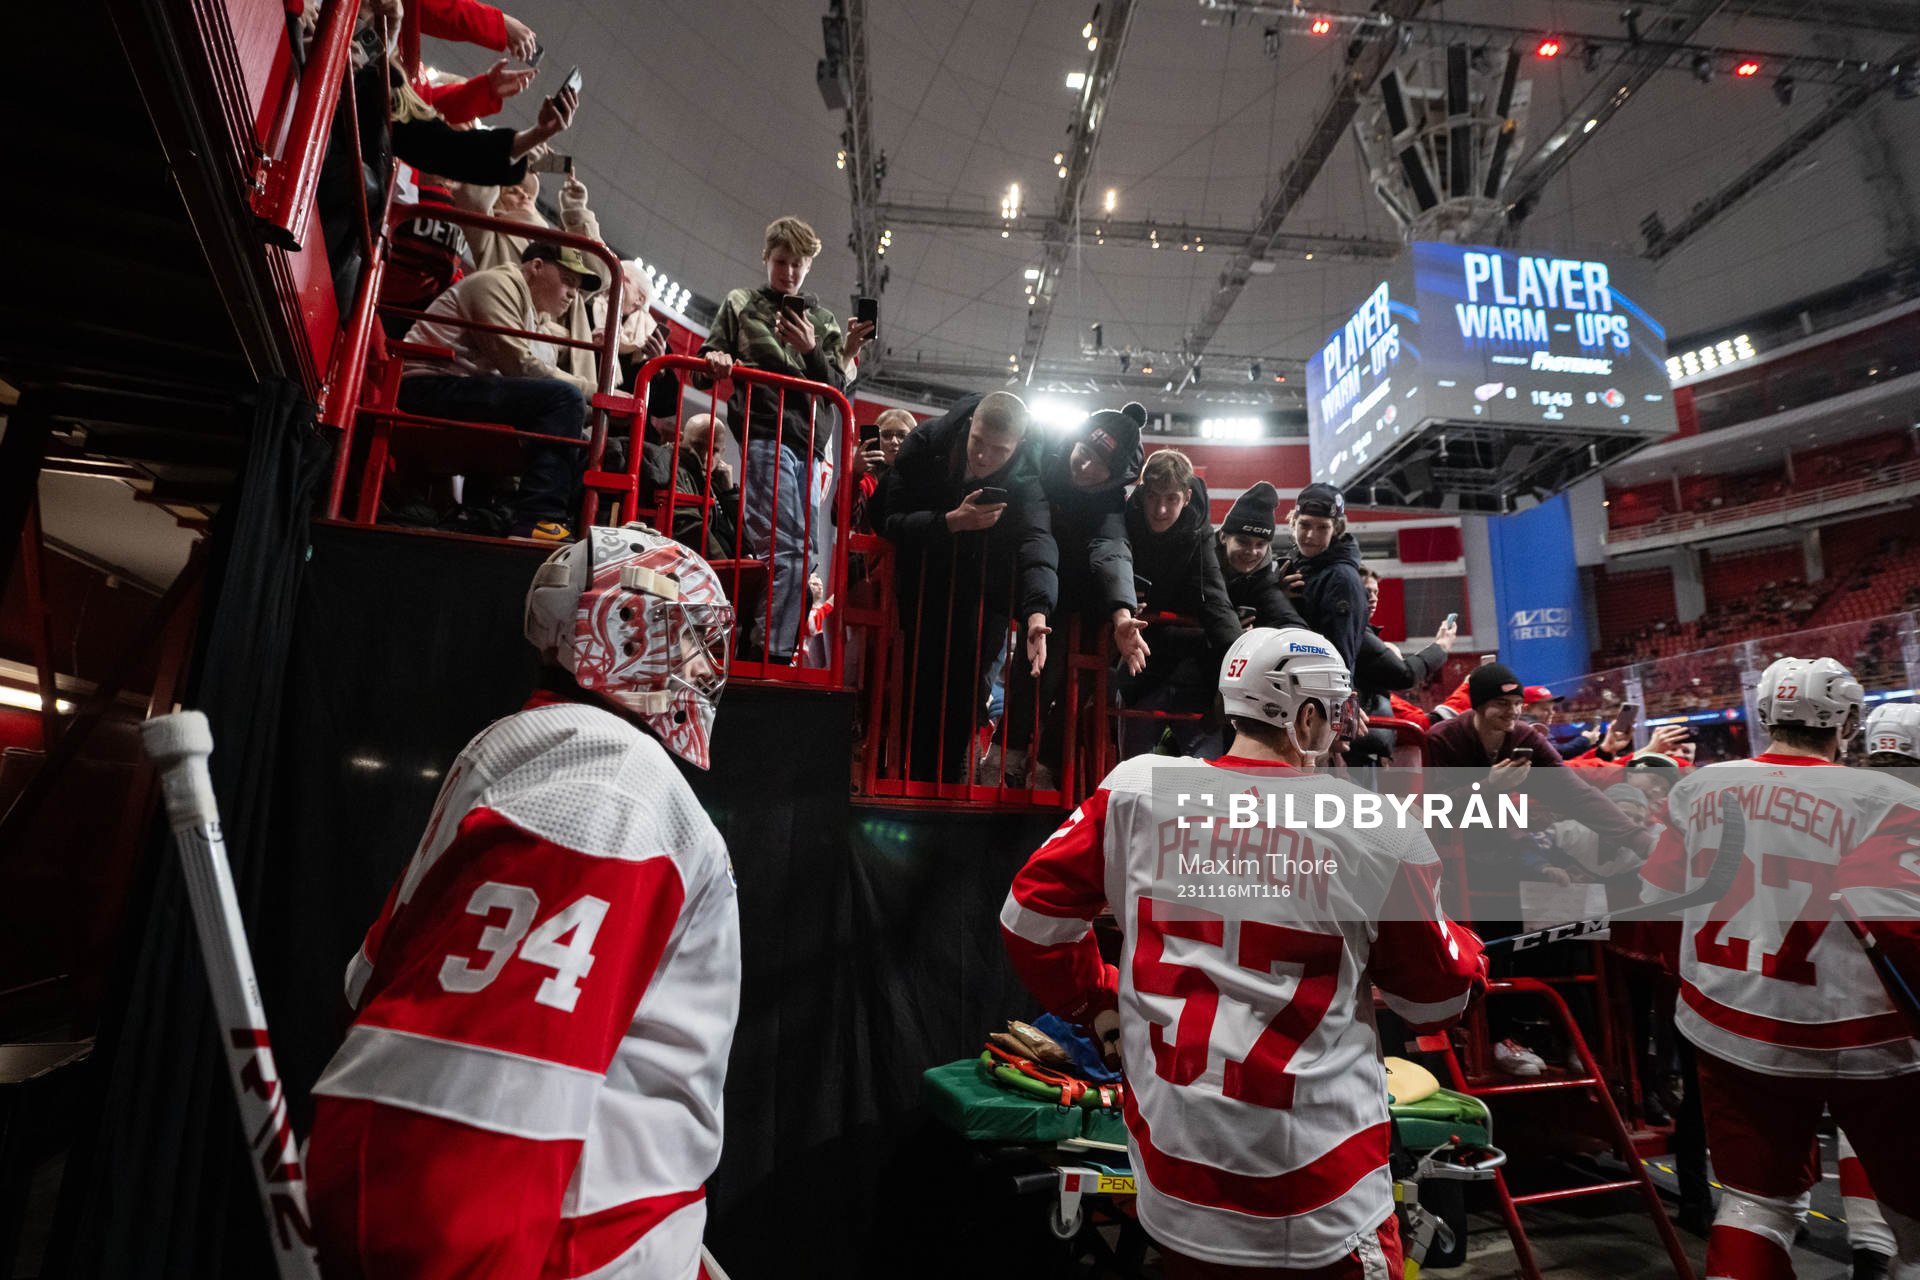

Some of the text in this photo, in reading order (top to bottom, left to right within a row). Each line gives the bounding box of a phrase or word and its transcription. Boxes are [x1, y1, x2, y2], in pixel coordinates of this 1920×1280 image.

[1463, 252, 1613, 312] PLAYER
[1323, 281, 1391, 391] PLAYER
[1227, 659, 1248, 678] 57
[1776, 685, 1798, 699] 27
[1879, 738, 1897, 750] 53
[1512, 914, 1612, 952] CCM
[1690, 847, 1839, 986] 27
[438, 881, 611, 1013] 34
[1132, 896, 1344, 1109] 57
[1100, 1177, 1137, 1190] PEN
